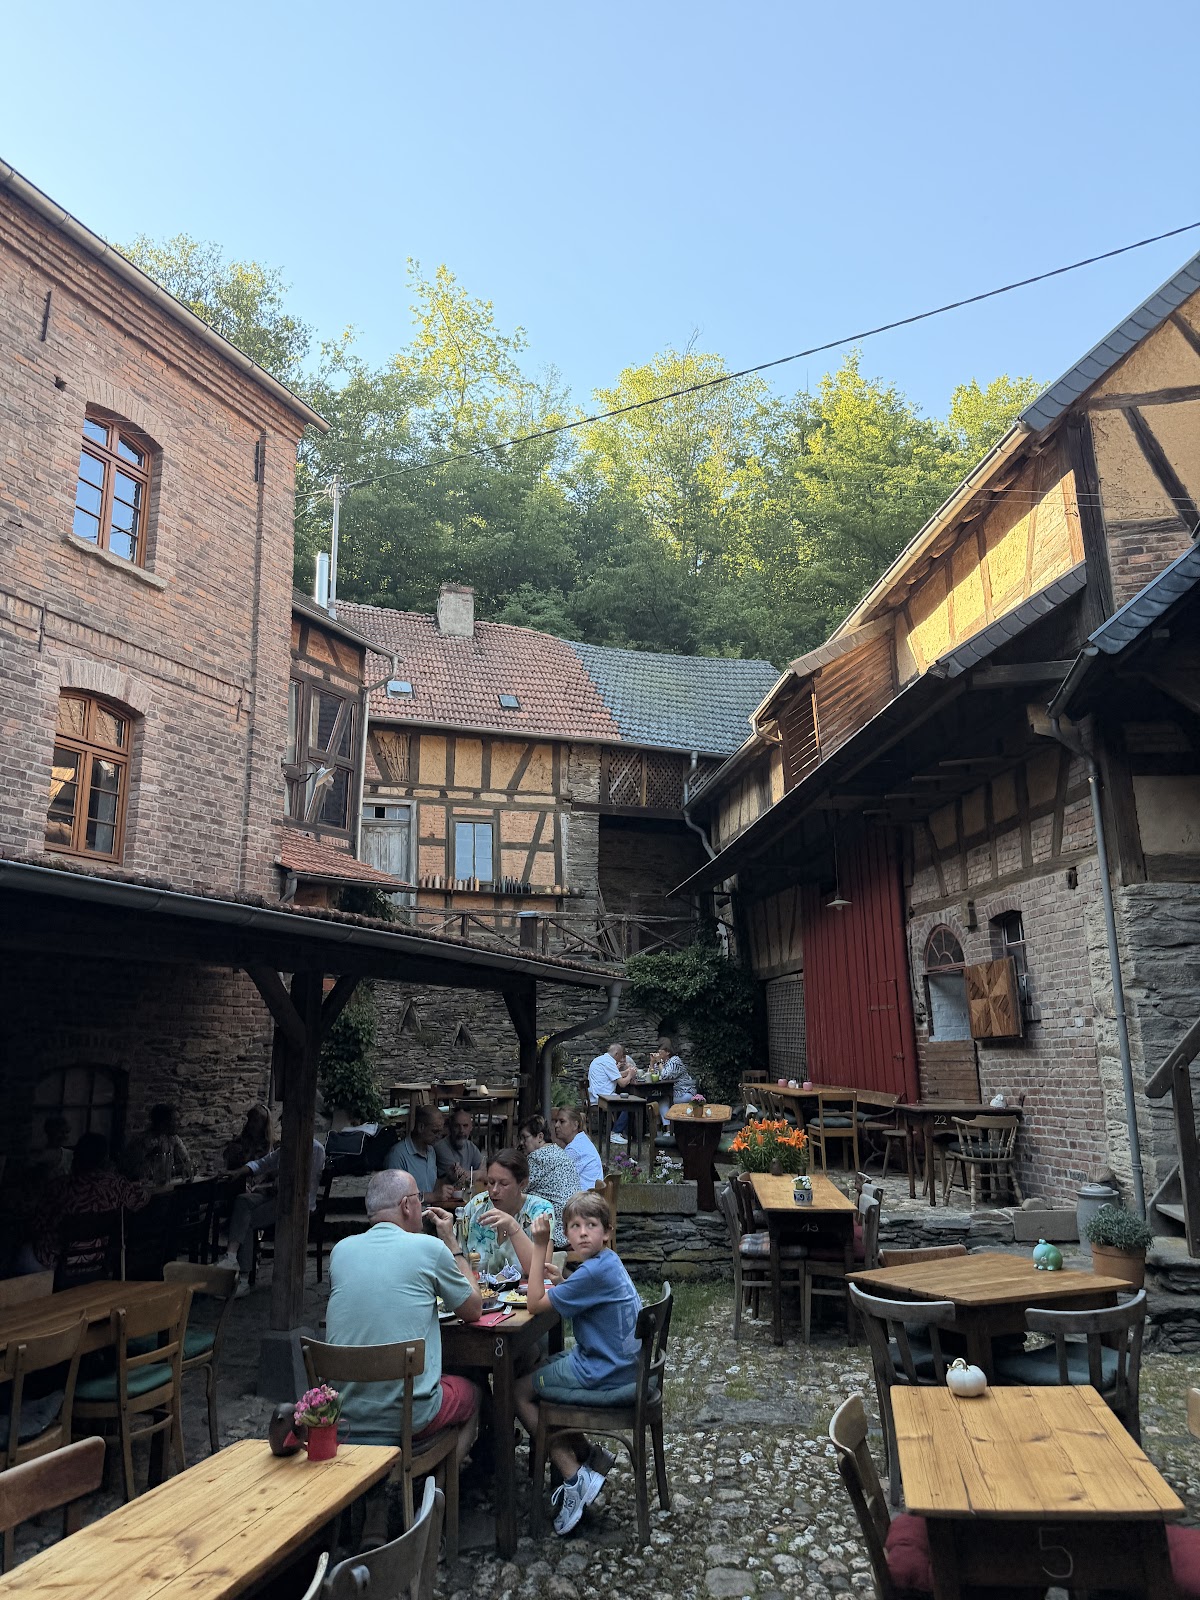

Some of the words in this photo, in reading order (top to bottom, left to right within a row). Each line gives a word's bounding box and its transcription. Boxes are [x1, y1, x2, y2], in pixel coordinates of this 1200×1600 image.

[934, 1115, 948, 1126] 22
[802, 1222, 819, 1232] 13
[495, 1337, 504, 1357] 8
[1039, 1526, 1074, 1579] 5
